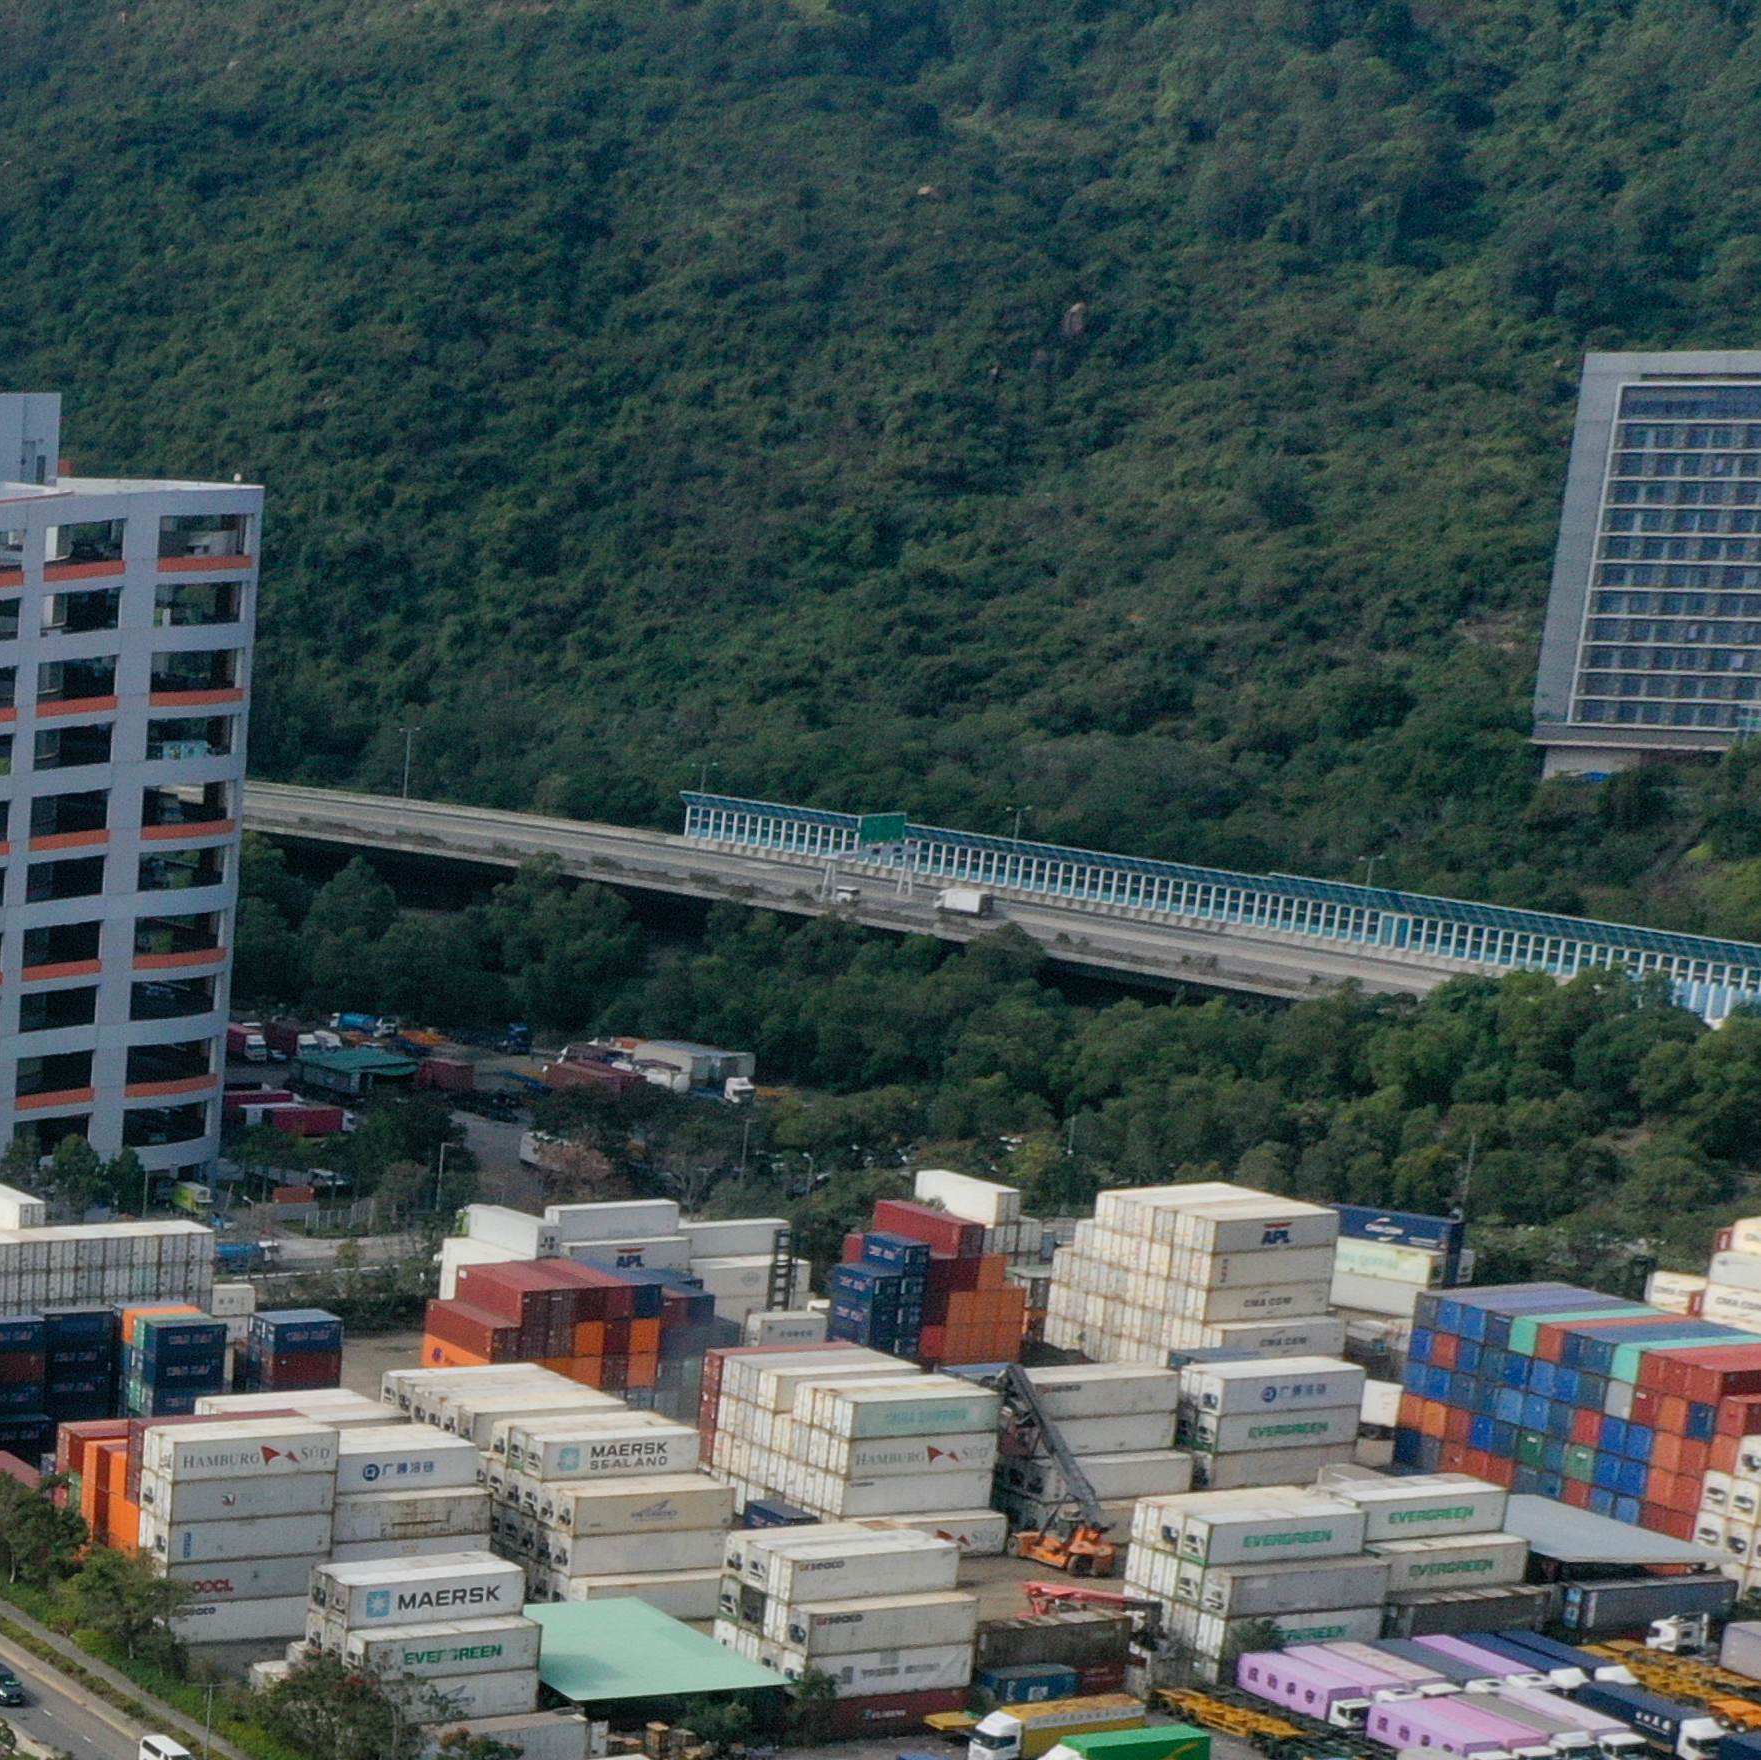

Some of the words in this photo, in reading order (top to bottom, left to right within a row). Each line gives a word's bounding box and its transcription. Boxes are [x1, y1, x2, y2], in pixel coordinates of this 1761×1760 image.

[1261, 1230, 1290, 1245] APL
[616, 1255, 645, 1267] APL
[1248, 1421, 1329, 1439] EVERGREEN
[591, 1441, 668, 1458] MAERSK
[183, 1452, 260, 1469] HAMBURG
[590, 1455, 668, 1471] SEALAND
[855, 1451, 925, 1466] HAMBURG
[1388, 1505, 1475, 1524] EVERGREEN
[1243, 1530, 1332, 1547] EVERGREEN
[1408, 1559, 1495, 1577] EVERGREEN
[397, 1585, 501, 1611] MAERSK
